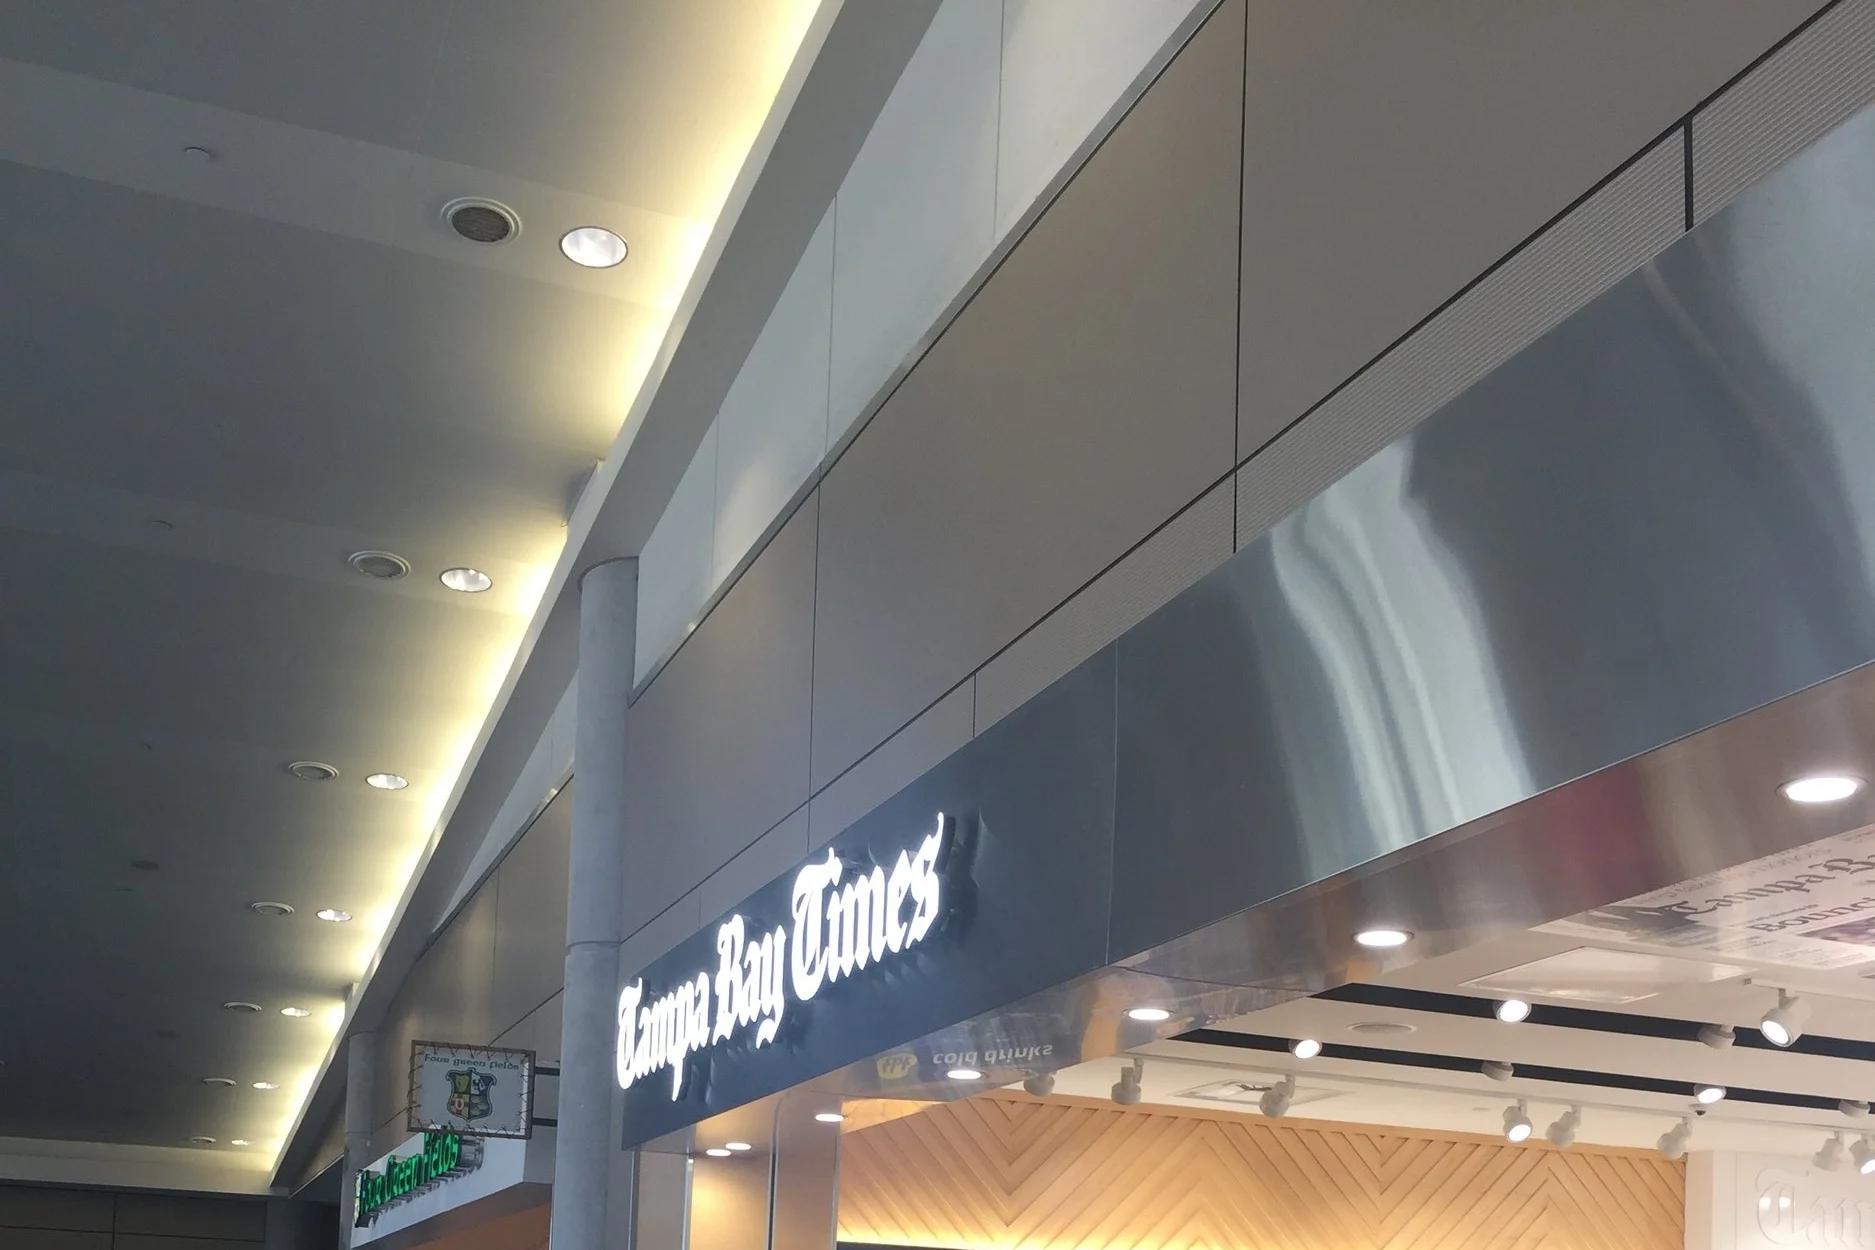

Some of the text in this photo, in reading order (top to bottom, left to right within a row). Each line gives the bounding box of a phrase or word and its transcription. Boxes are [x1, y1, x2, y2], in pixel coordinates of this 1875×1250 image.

[617, 812, 944, 1101] Tampa Bay Times
